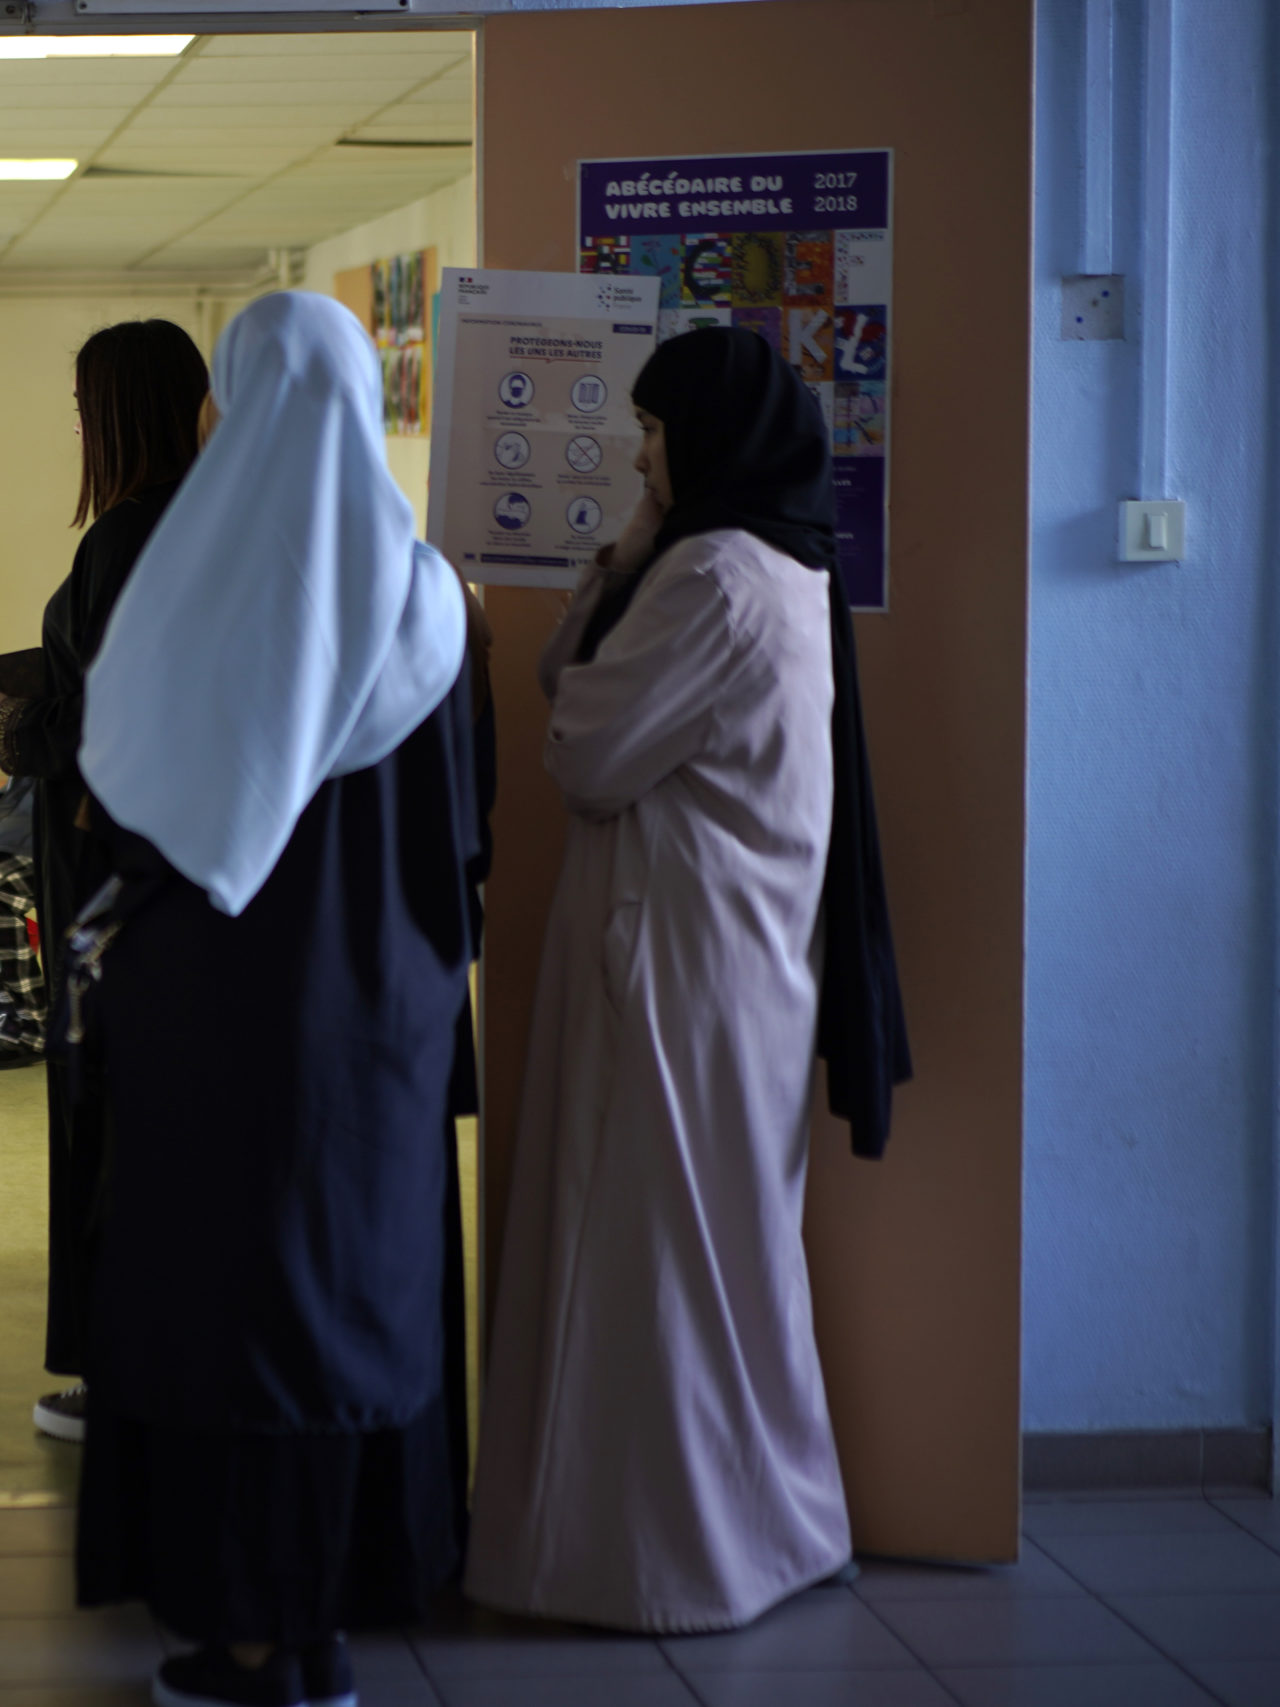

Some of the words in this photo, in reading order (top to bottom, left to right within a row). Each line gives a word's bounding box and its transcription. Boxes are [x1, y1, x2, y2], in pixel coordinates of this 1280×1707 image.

[605, 171, 743, 197] ABÉCÉDAIRE
[750, 175, 784, 192] DU
[813, 172, 858, 190] 2017
[605, 201, 671, 220] VIVRE
[678, 198, 793, 219] ENSEMBLE
[813, 195, 858, 213] 2018
[509, 346, 525, 355] LES
[527, 347, 546, 357] UNS
[549, 348, 564, 358] LES
[566, 349, 603, 360] AUTRES
